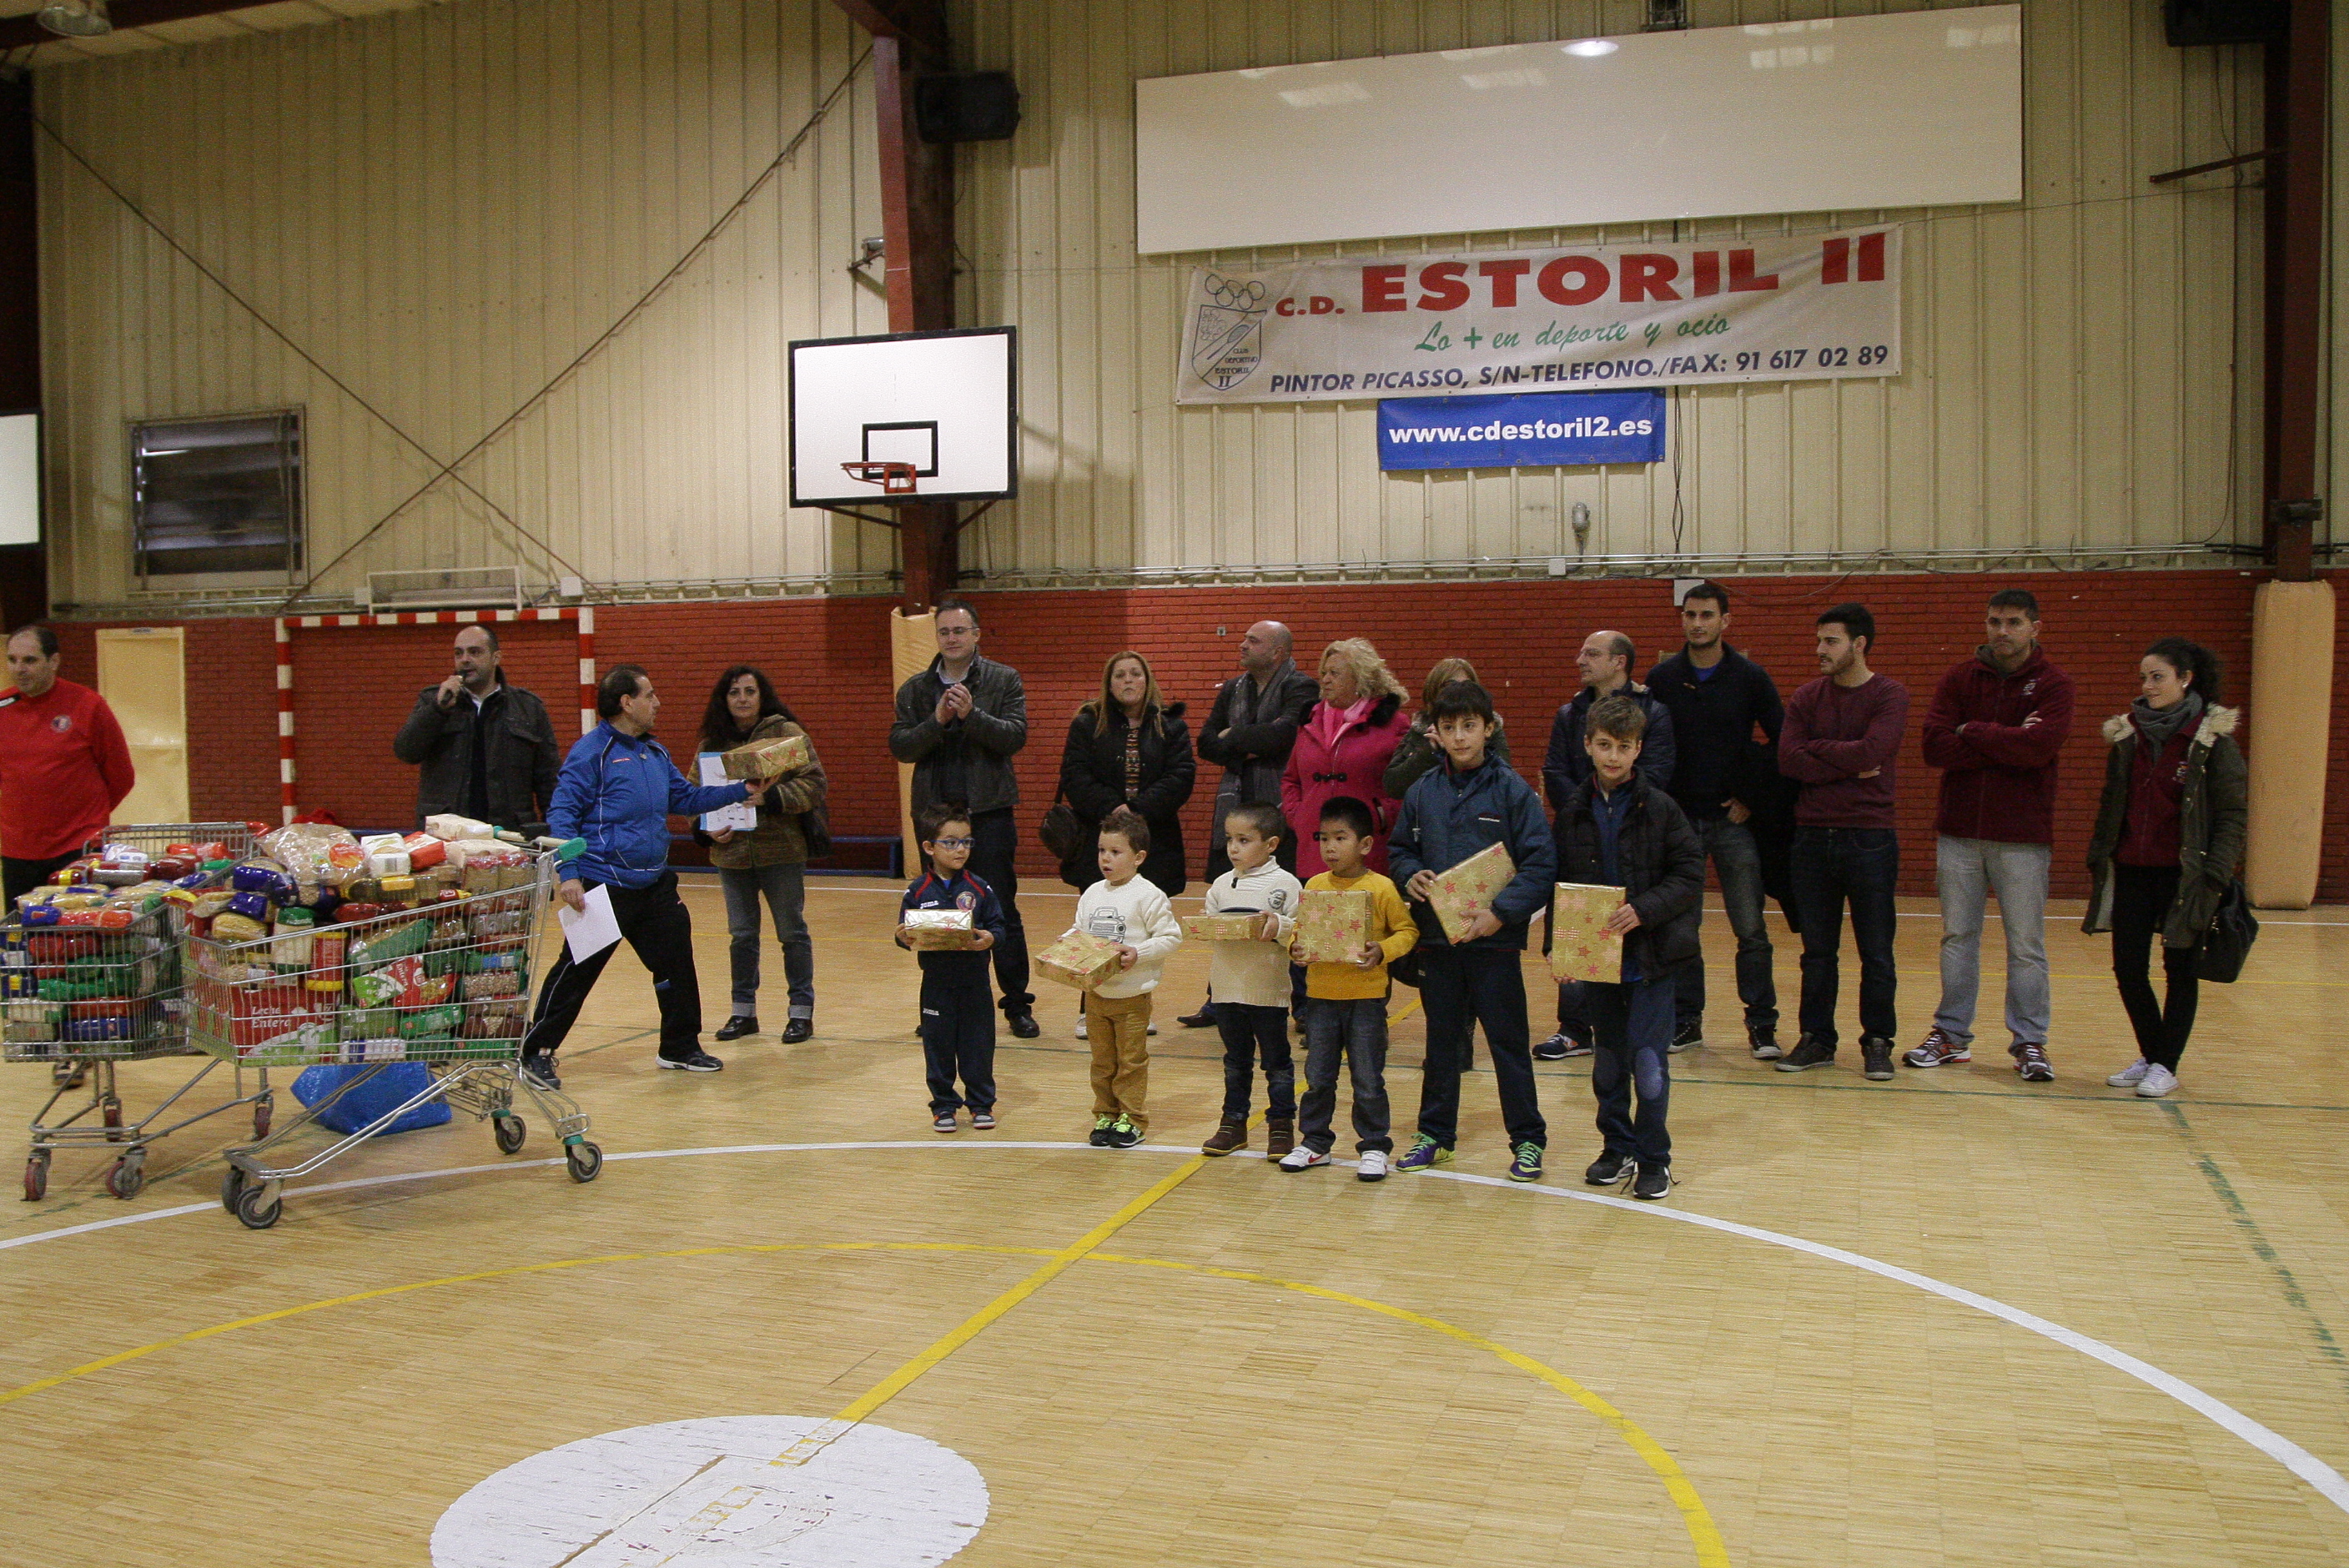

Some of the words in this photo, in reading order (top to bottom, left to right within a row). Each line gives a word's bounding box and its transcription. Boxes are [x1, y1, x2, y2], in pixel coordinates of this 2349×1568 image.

[1275, 296, 1345, 317] C.D.
[1361, 249, 1779, 313] ESTORIL
[1821, 232, 1886, 285] II
[1414, 321, 1452, 352] Lo
[1492, 330, 1521, 349] en
[1536, 320, 1630, 352] deporte
[1645, 323, 1662, 347] y
[1677, 313, 1732, 337] ocio
[1219, 375, 1231, 387] II
[1270, 373, 1355, 393] PINTOR
[1362, 367, 1469, 389] PICASSO,
[1736, 350, 1760, 372] 91
[1769, 349, 1808, 369] 617
[1818, 346, 1848, 368] 02
[1857, 344, 1889, 366] 89
[1389, 416, 1653, 444] www.cdestoril2.es
